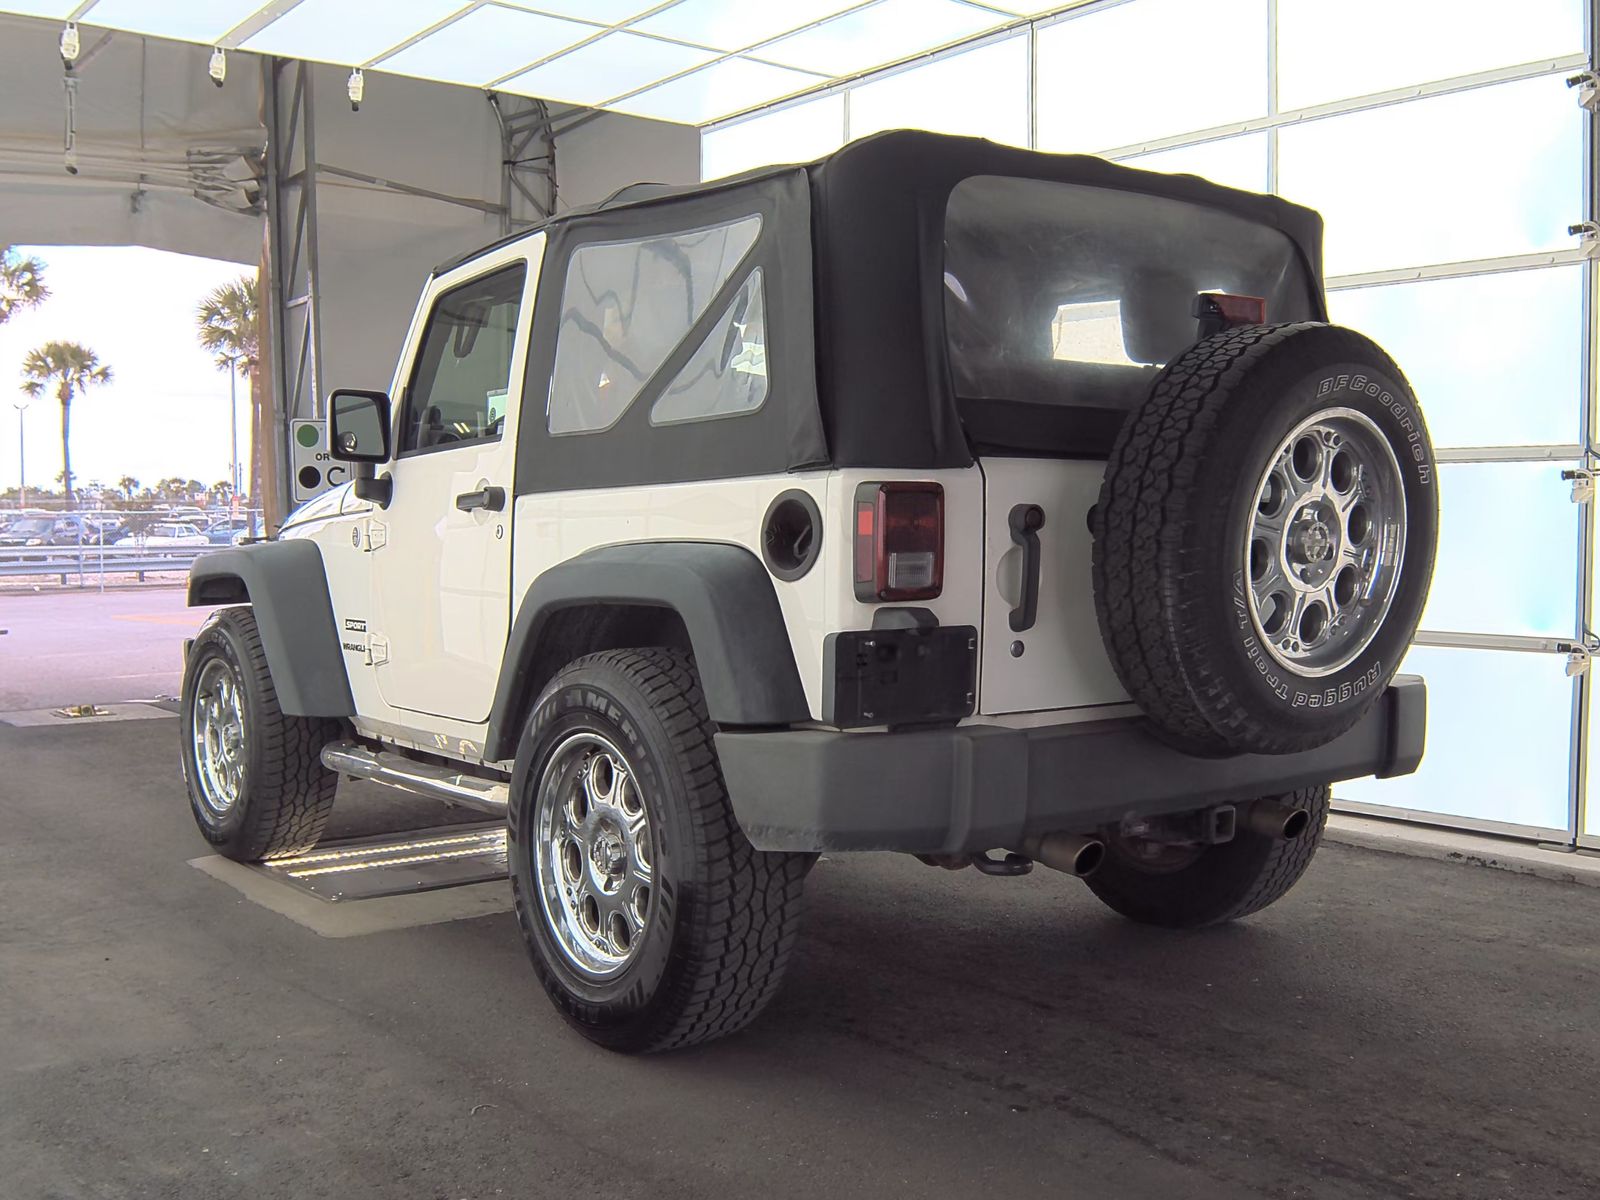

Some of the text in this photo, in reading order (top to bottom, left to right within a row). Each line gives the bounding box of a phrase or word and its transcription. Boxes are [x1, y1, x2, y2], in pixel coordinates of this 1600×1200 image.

[1317, 374, 1430, 484] BFGoodrich
[315, 453, 330, 461] OR
[345, 619, 367, 632] SPORT
[342, 642, 366, 652] WRANGL
[1243, 636, 1288, 700] Trail
[1291, 661, 1381, 707] Rugged
